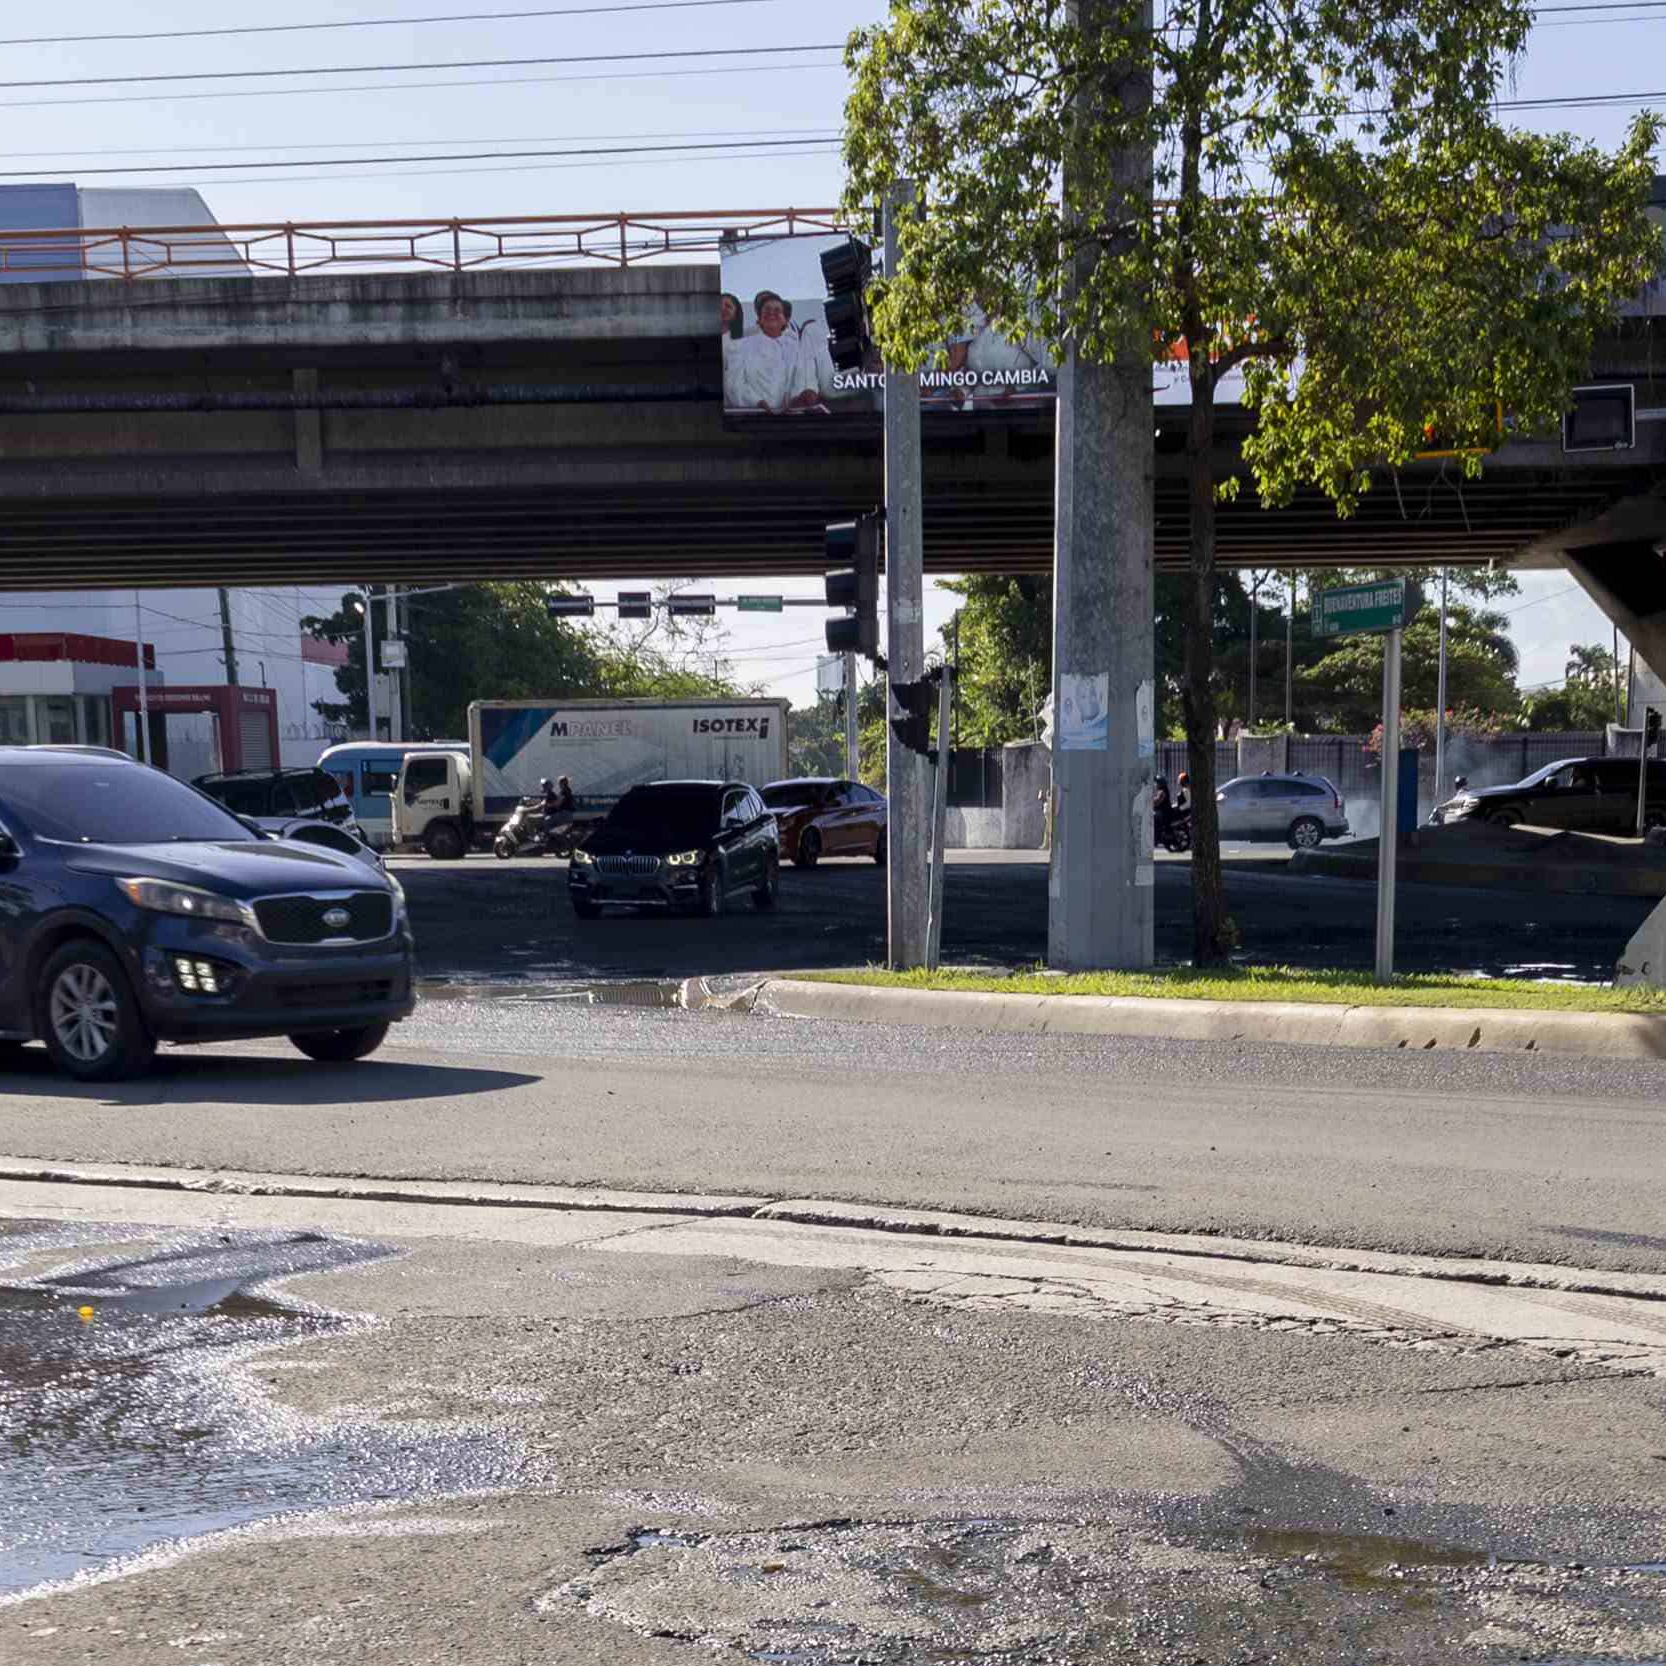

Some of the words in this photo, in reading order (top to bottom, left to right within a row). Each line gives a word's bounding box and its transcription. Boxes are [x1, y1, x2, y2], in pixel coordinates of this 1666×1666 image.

[919, 371, 978, 387] MINGO
[982, 369, 1049, 384] CAMBIA
[550, 719, 632, 737] MPANEL
[693, 717, 758, 733] ISOTEX
